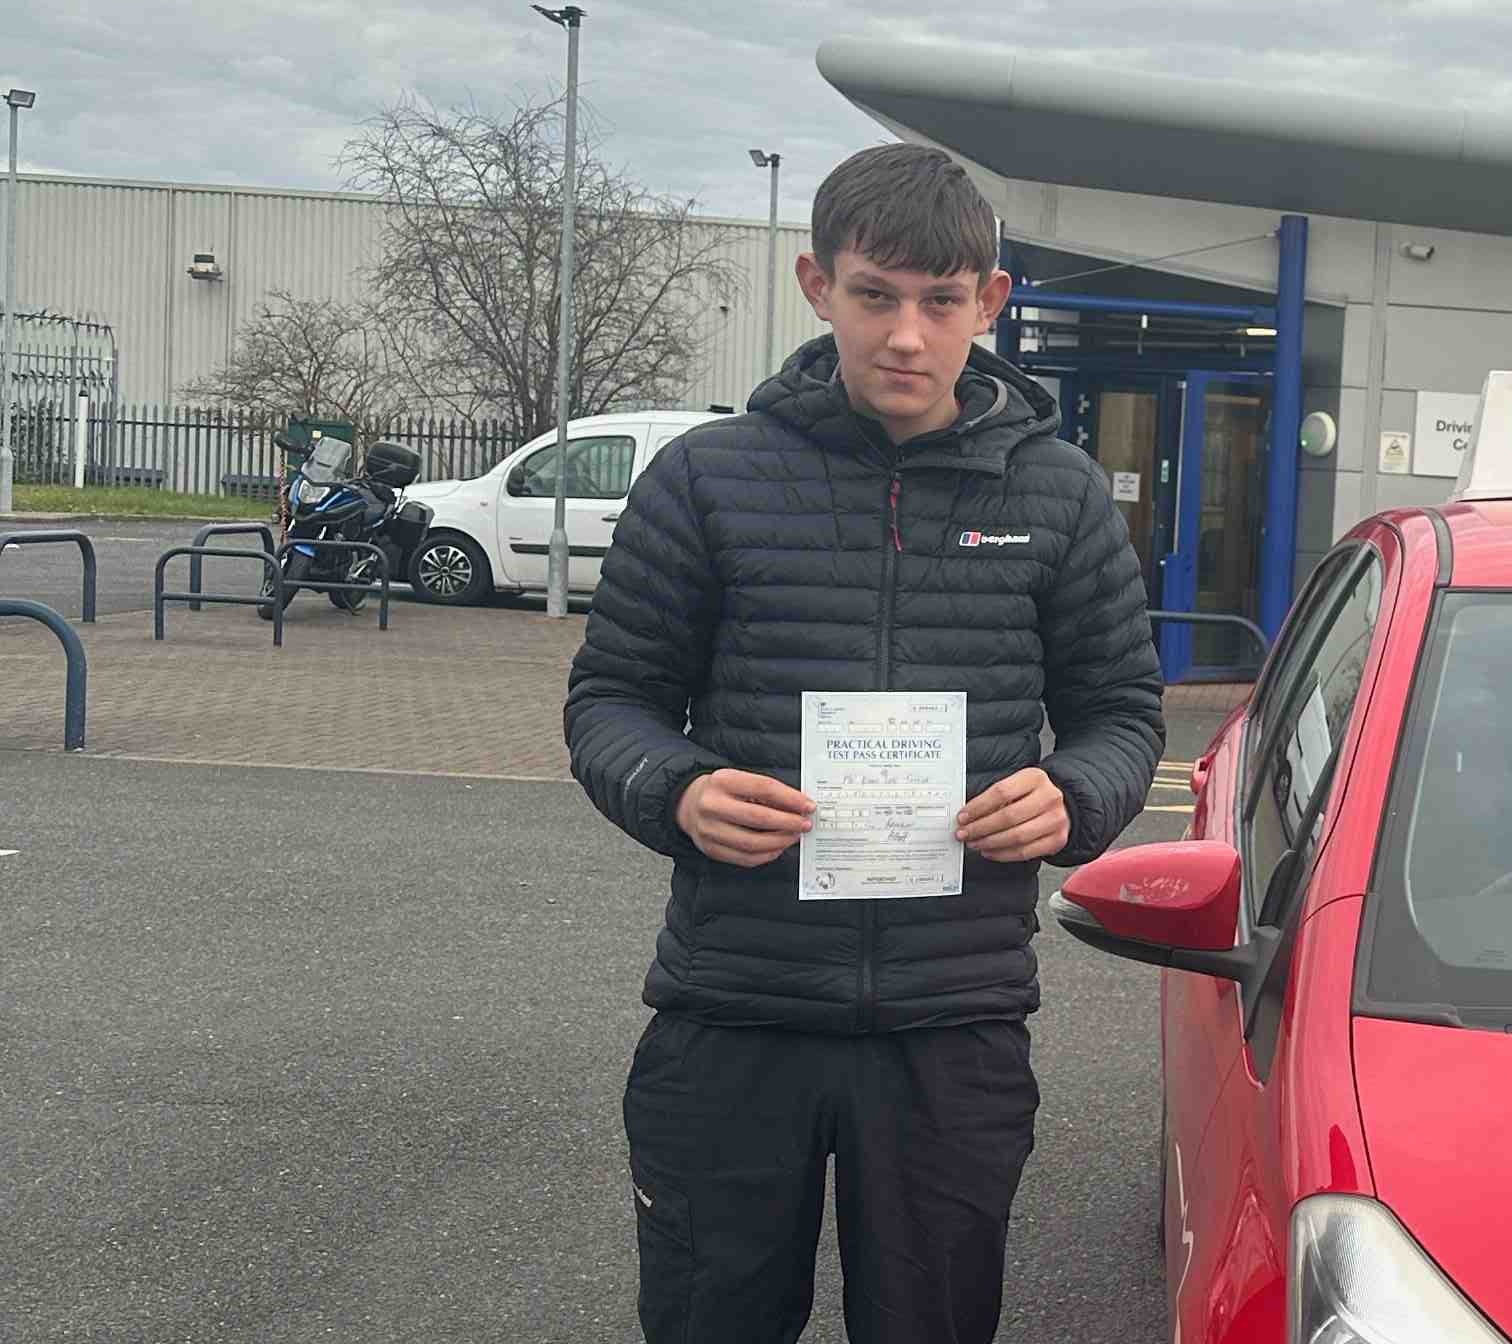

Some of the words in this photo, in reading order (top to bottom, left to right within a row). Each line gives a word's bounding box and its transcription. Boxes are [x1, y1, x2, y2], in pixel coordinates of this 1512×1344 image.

[826, 738, 888, 750] PRACTICAL
[891, 738, 943, 750] DRIVING
[828, 750, 849, 760] TEST
[853, 750, 877, 760] PASS
[879, 750, 942, 760] CERTIFICATE
